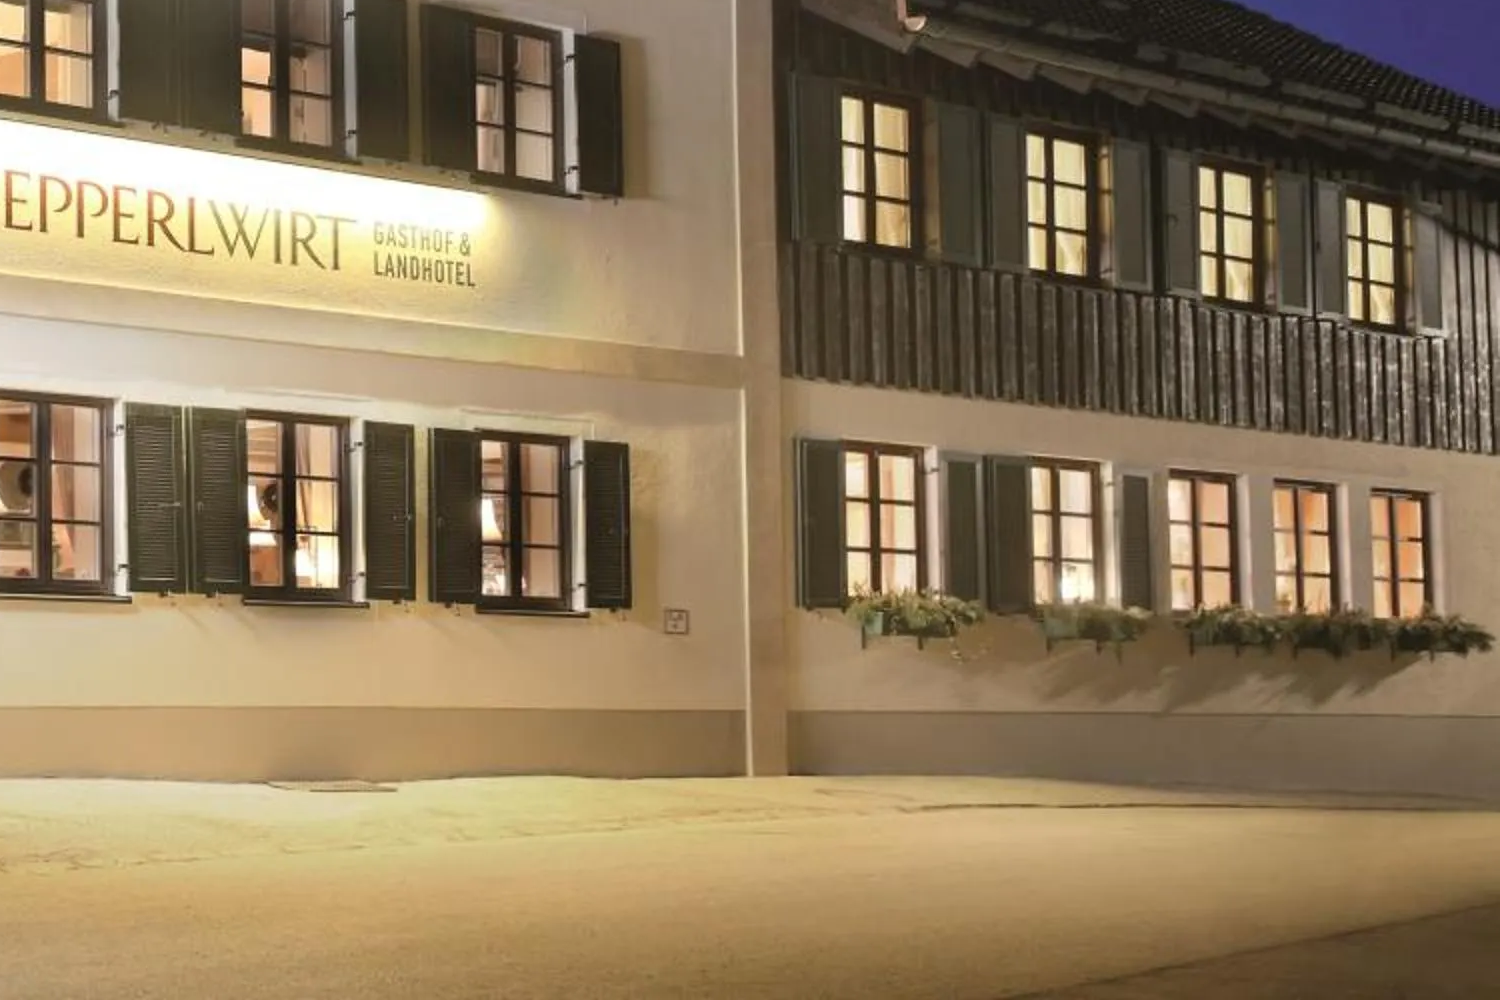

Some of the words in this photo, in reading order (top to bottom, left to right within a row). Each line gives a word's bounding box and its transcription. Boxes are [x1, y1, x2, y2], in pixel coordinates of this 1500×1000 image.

[373, 221, 454, 255] GASTHOF
[459, 231, 471, 257] &
[373, 250, 476, 287] LANDHOTEL
